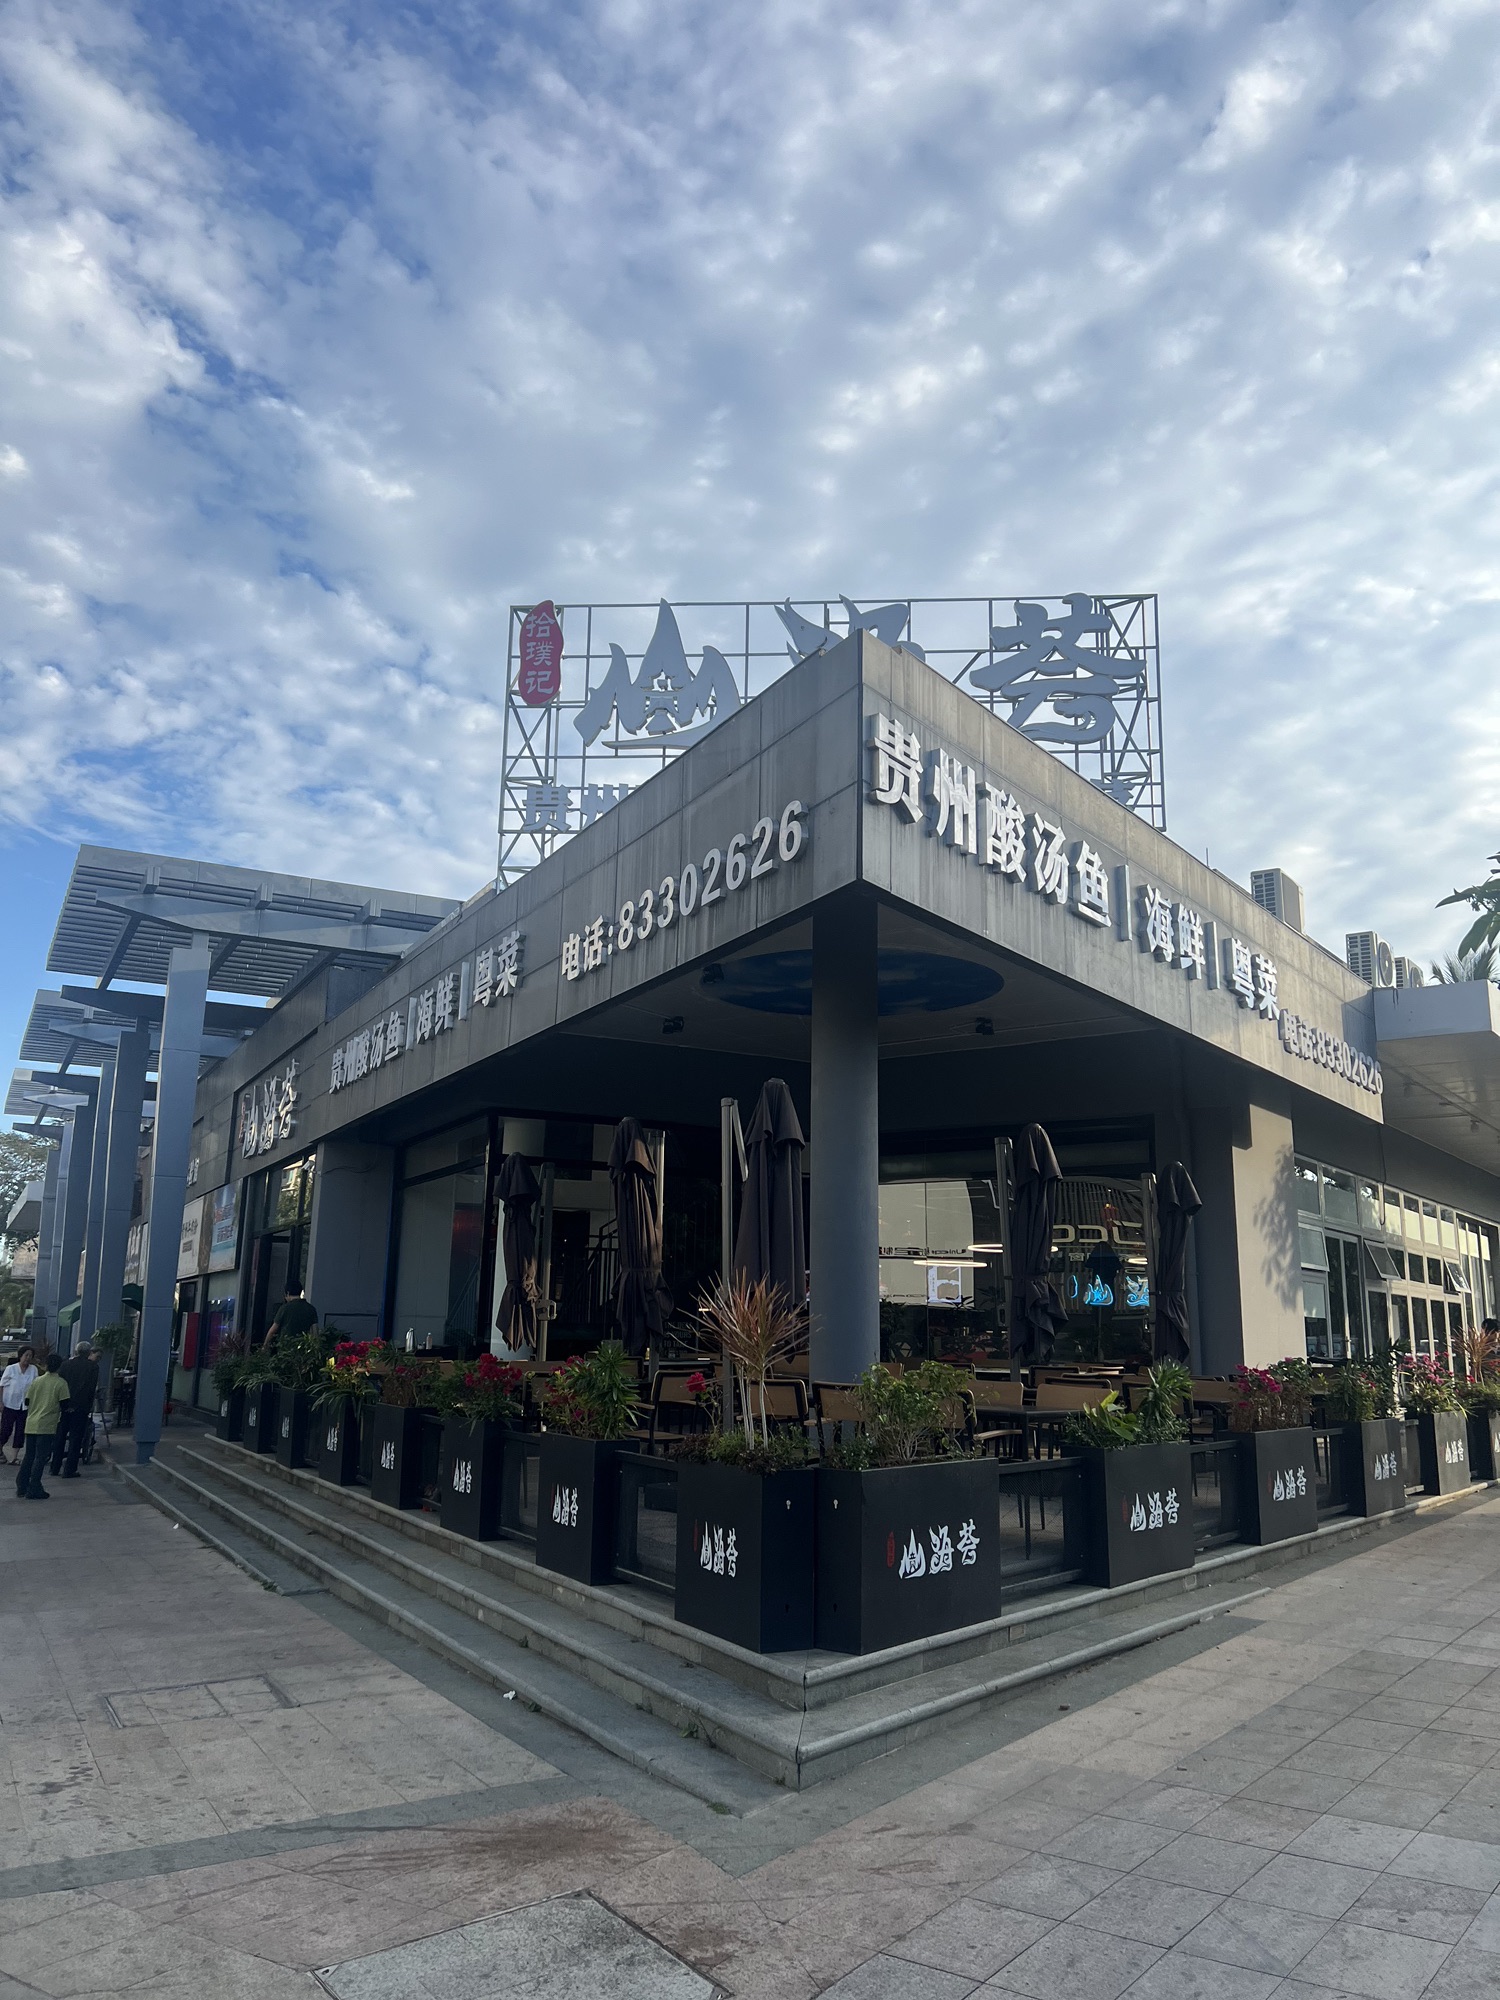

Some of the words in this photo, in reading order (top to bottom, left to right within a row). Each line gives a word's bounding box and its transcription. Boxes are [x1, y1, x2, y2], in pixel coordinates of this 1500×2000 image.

[561, 799, 810, 982] 电话:83302626
[868, 712, 1111, 928] 贵州酸汤鱼
[1138, 884, 1206, 980] 海鲜
[1225, 937, 1280, 1021] 粤菜
[330, 1011, 404, 1094] 贵州酸汤鱼
[416, 974, 460, 1045] 海鲜
[473, 931, 525, 1008] 粤菜
[1278, 1009, 1383, 1095] 电话:83302626
